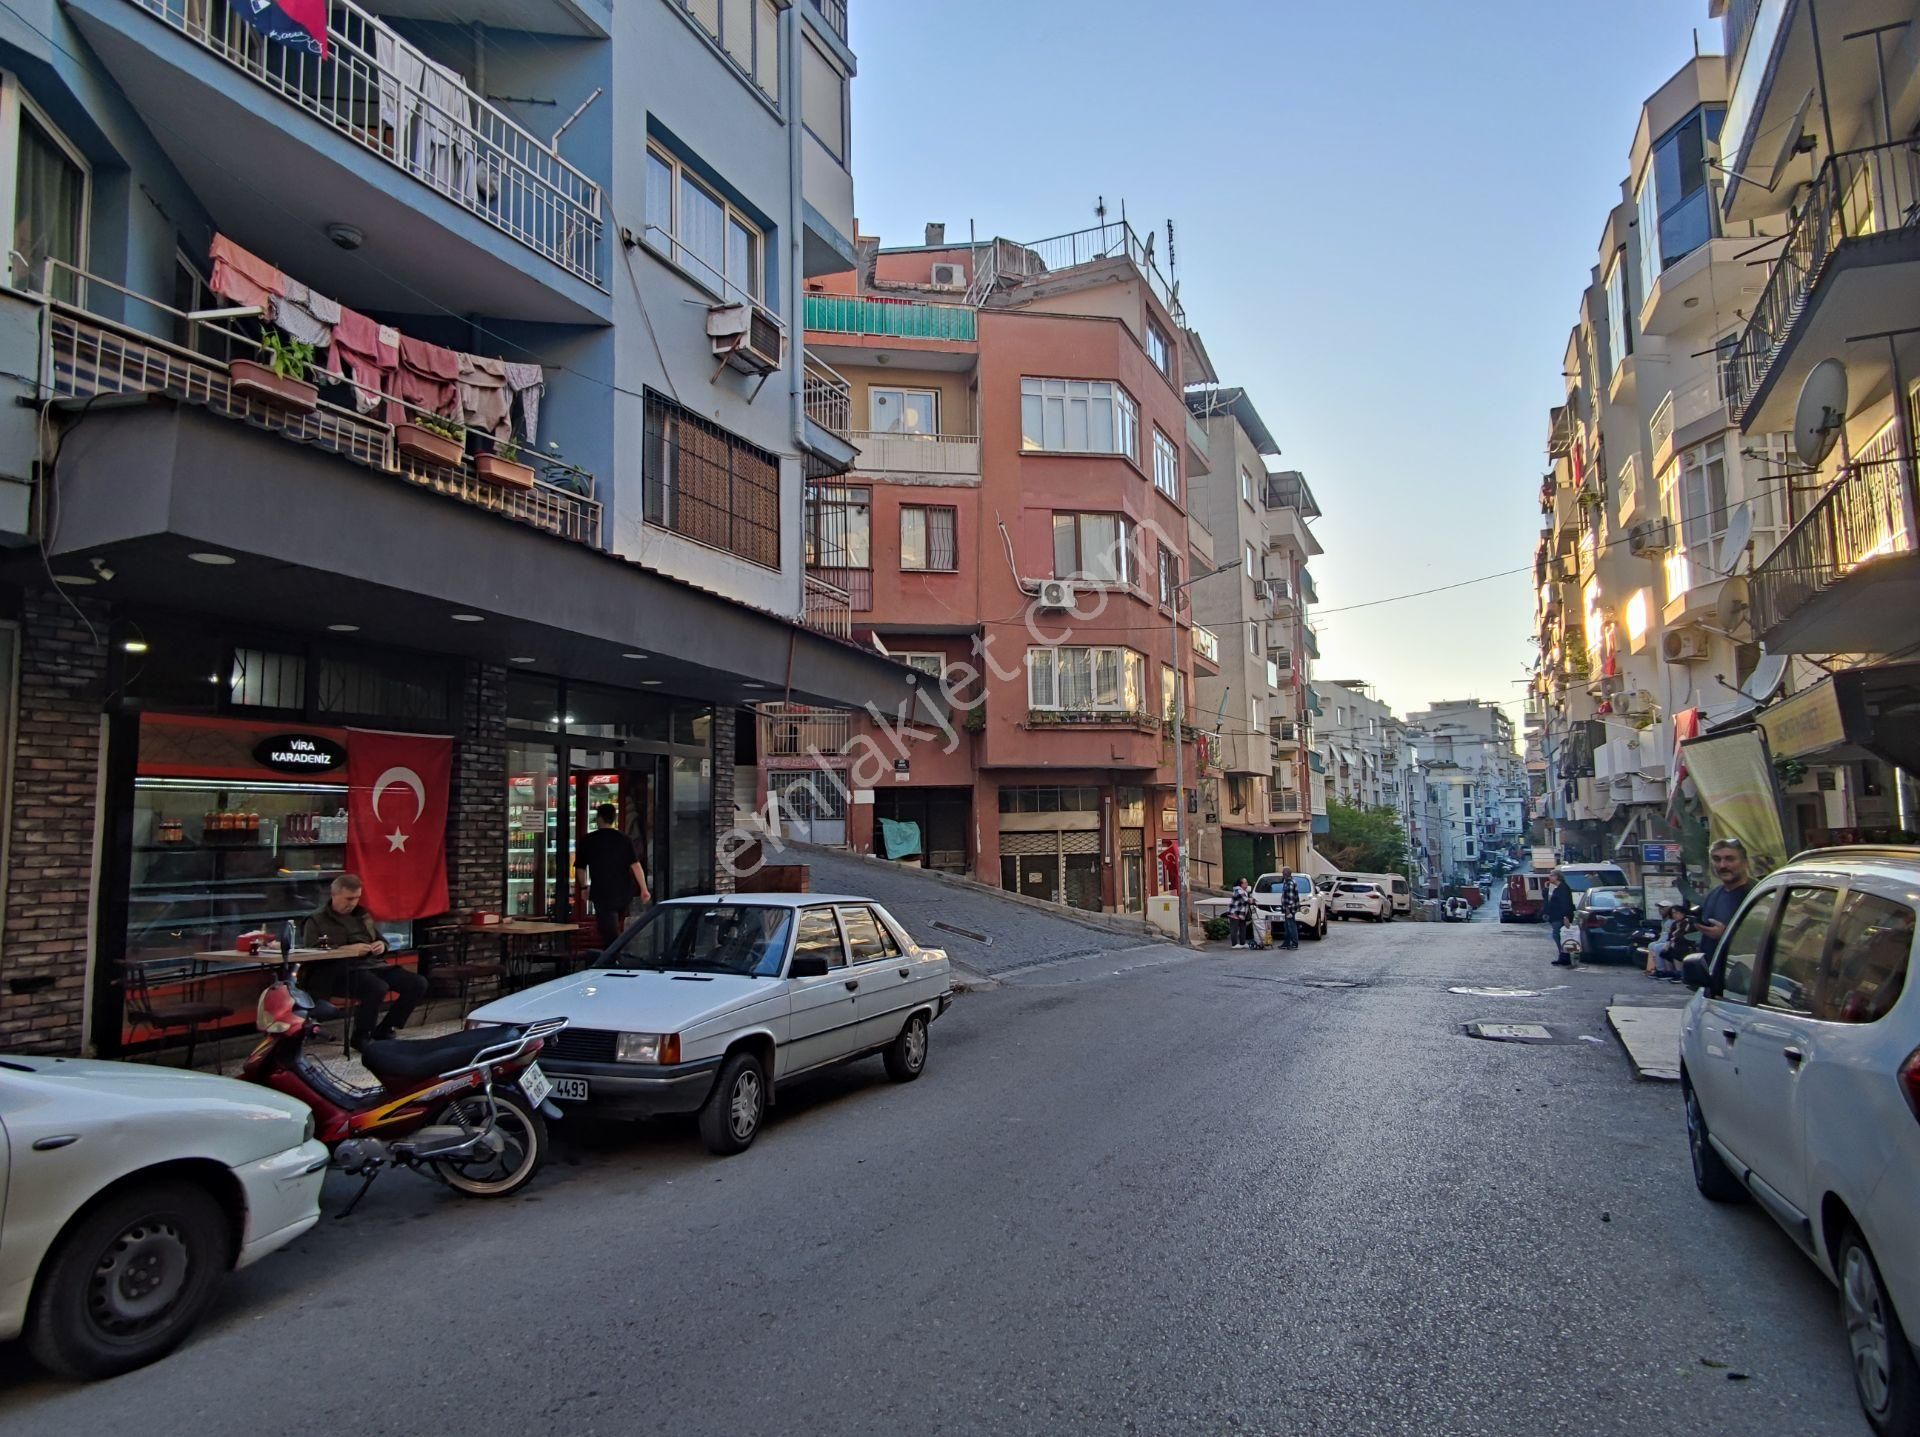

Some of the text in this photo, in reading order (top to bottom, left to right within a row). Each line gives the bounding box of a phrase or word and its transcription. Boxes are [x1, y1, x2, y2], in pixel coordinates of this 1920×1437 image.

[290, 739, 315, 751] VİRA
[271, 751, 331, 764] KARADENİZ
[556, 1080, 586, 1098] 4493
